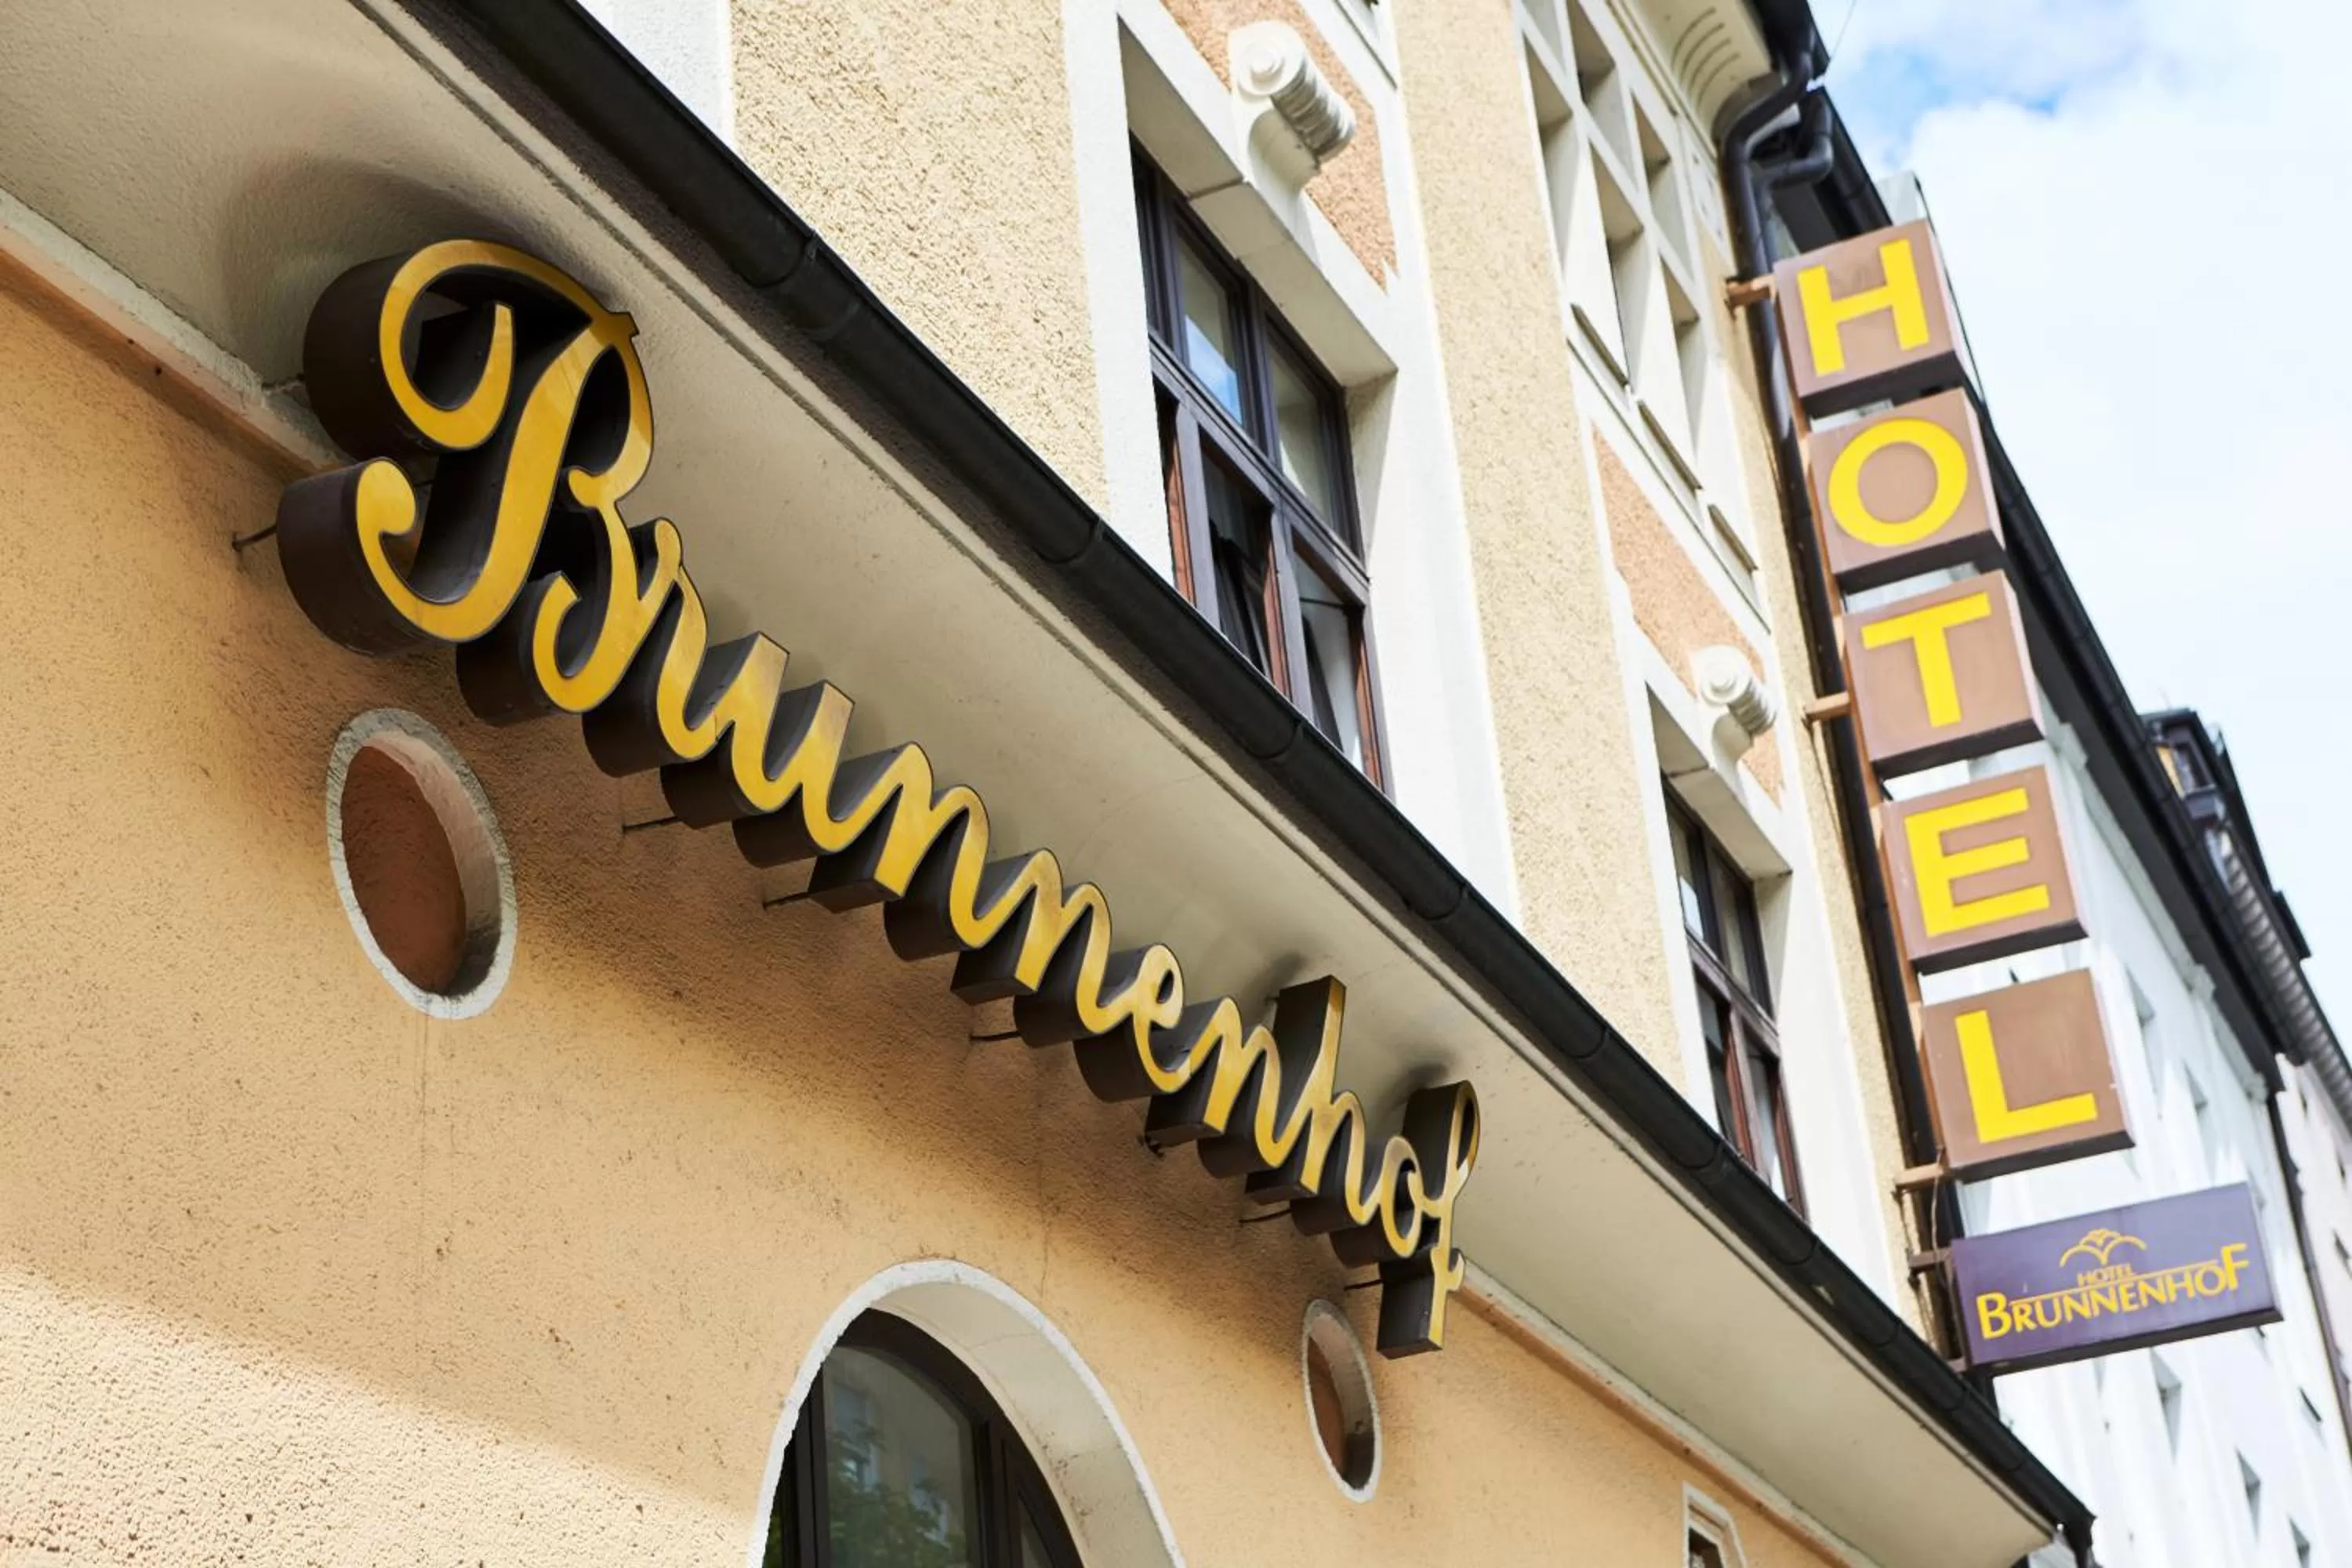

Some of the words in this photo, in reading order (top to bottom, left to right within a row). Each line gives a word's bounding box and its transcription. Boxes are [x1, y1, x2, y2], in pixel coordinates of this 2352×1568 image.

[356, 239, 1481, 1349] Brunnenhof
[1796, 238, 2097, 1143] HOTEL
[1976, 1243, 2249, 1338] BRUNNENHOF
[2078, 1263, 2136, 1287] HOTEL
